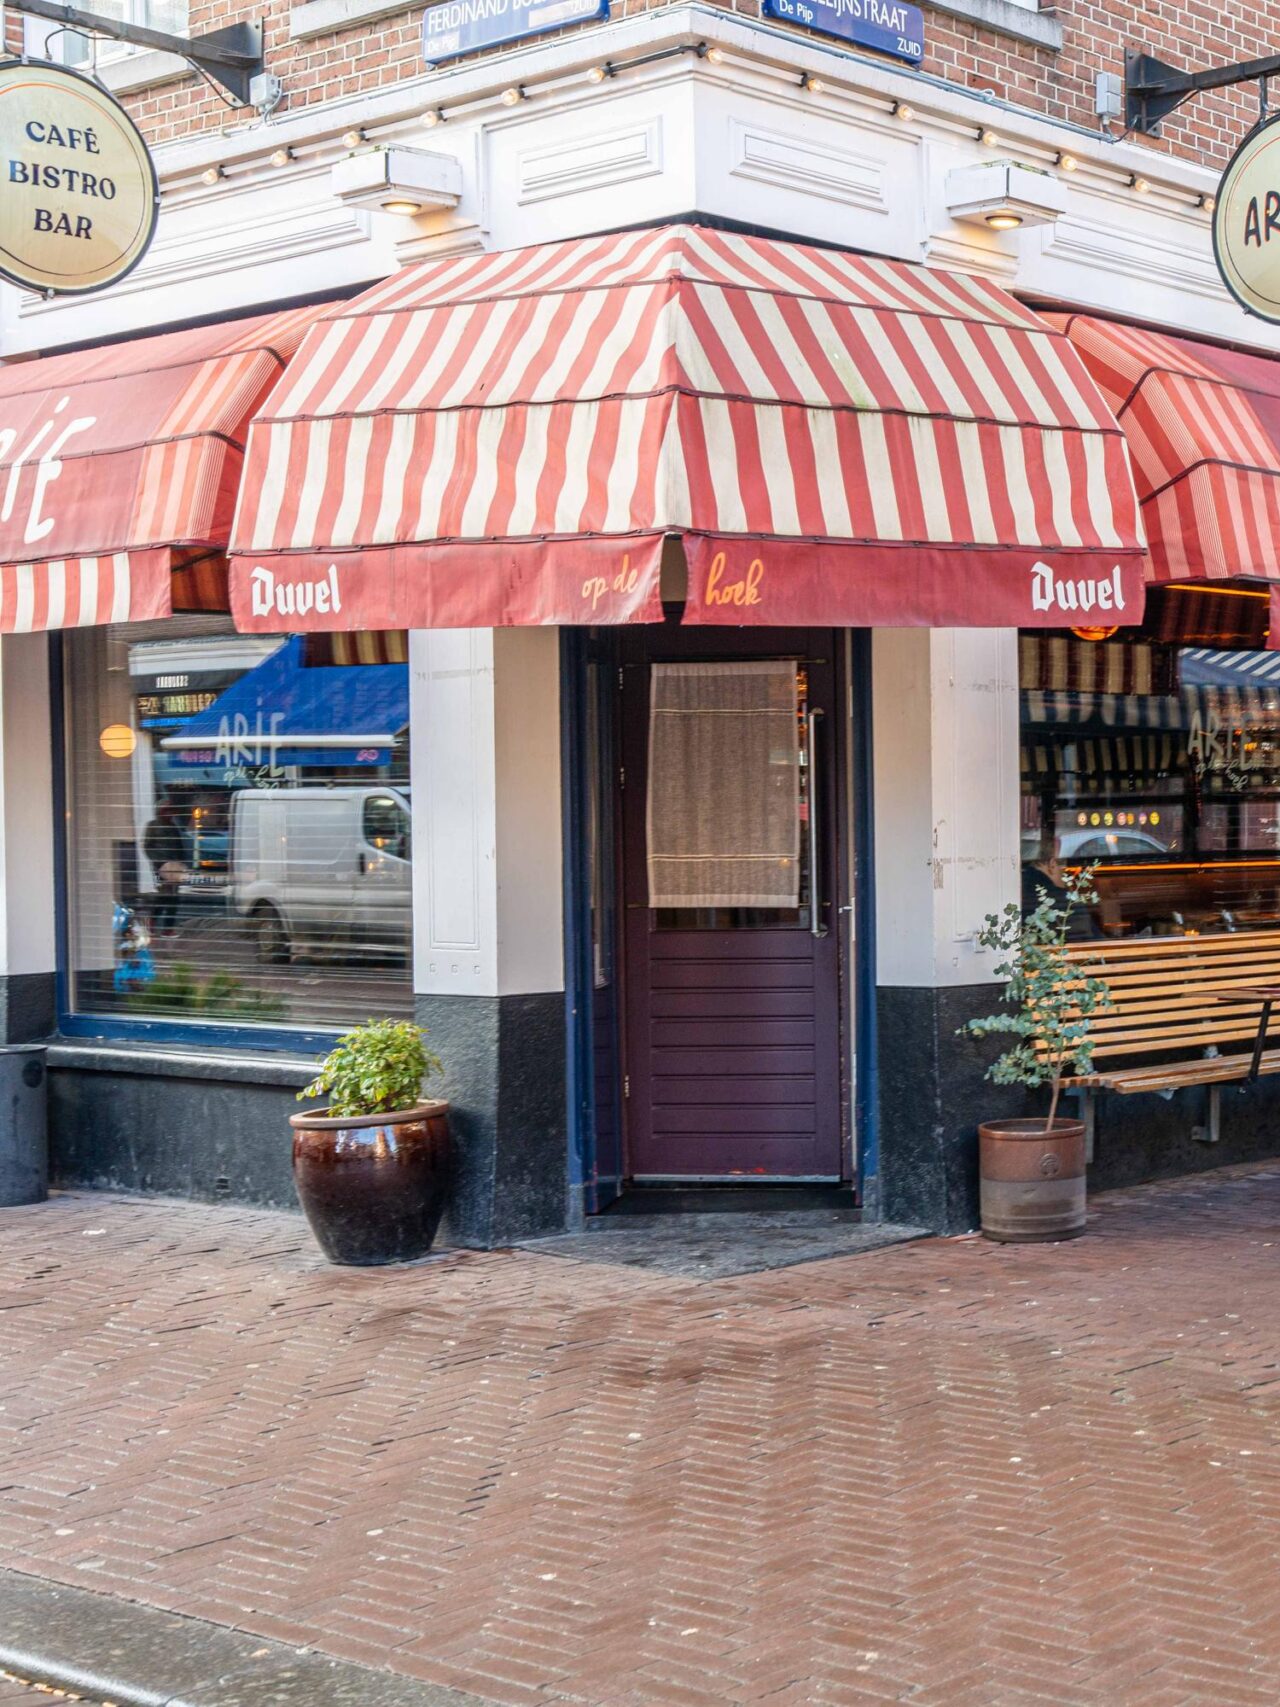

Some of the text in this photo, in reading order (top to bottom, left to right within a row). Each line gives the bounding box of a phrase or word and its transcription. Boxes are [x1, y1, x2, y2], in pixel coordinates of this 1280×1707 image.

[428, 0, 508, 34] FERDINAND
[779, 0, 814, 23] De Pijp
[896, 37, 921, 56] ZUID
[25, 121, 100, 155] CAFÉ
[9, 160, 116, 200] BISTRO
[33, 208, 92, 240] BAR
[250, 566, 342, 617] Duvel
[582, 552, 764, 611] op de hoek
[1030, 561, 1126, 612] Duvel
